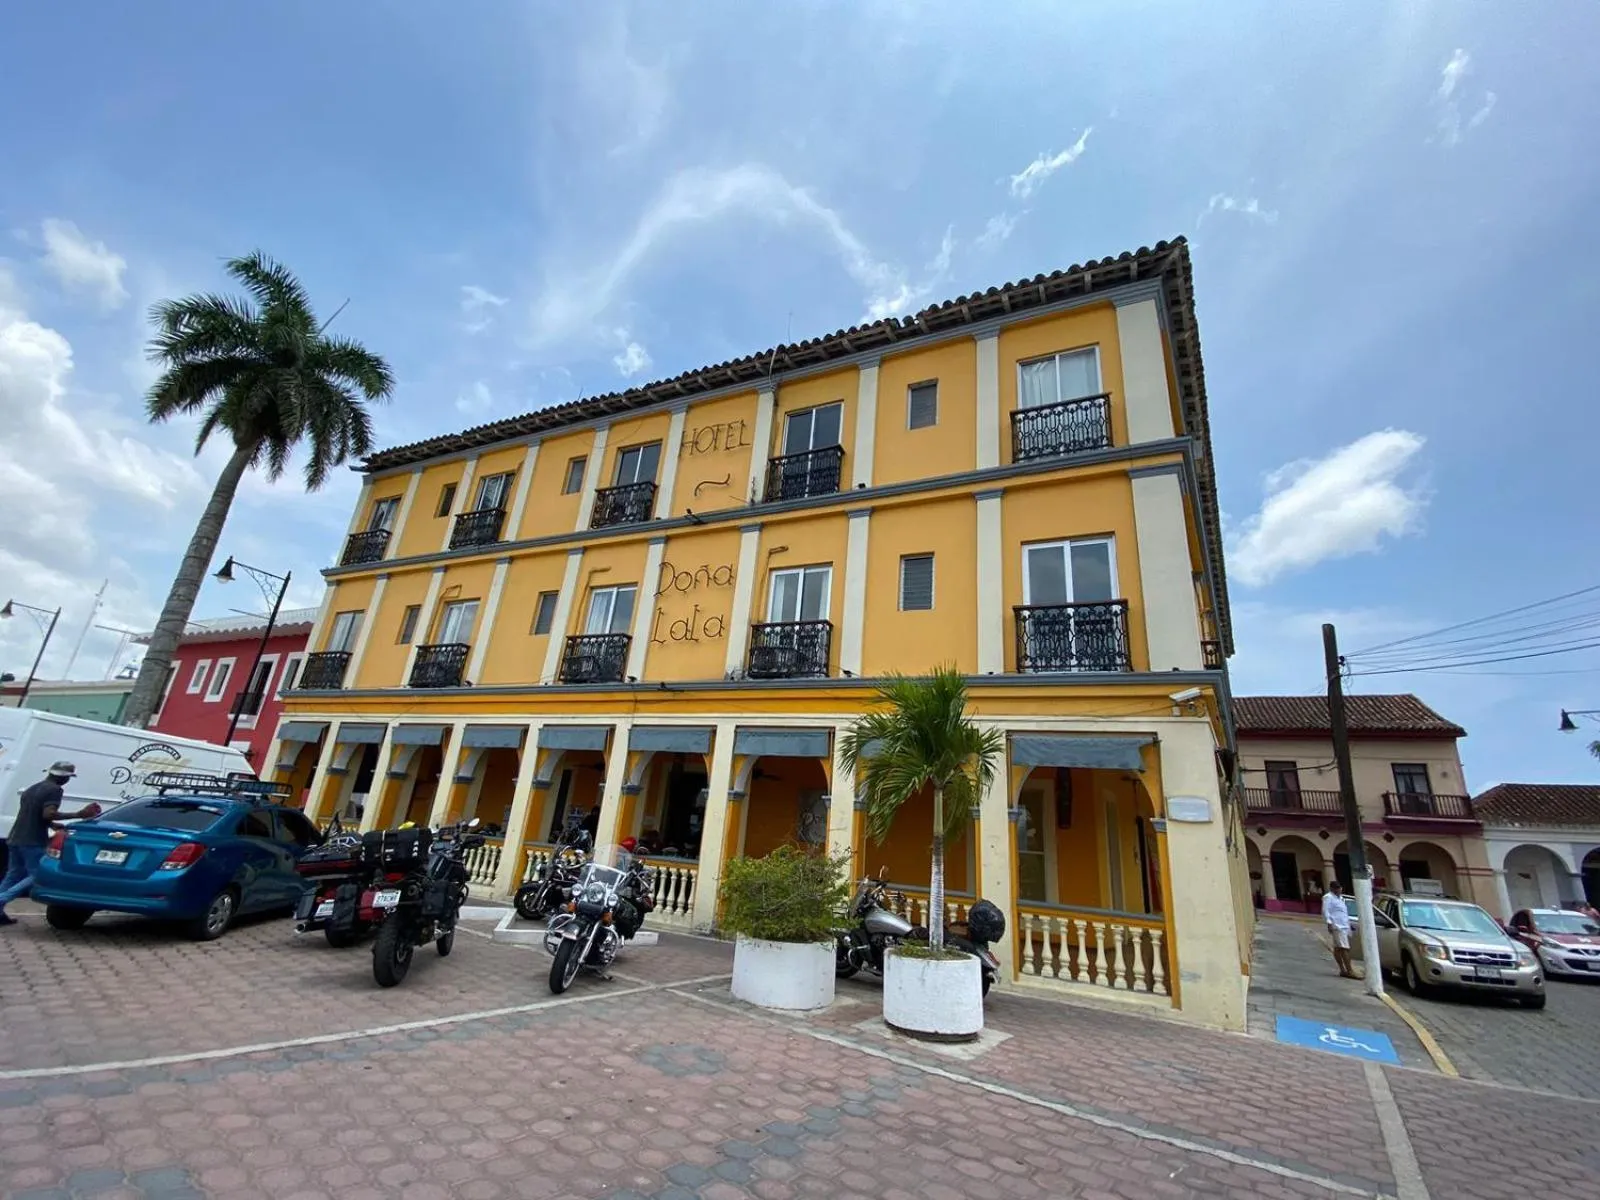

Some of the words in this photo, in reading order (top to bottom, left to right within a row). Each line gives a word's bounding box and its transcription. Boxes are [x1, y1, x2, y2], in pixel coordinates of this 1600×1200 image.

[679, 419, 750, 456] HOTEL
[654, 561, 733, 596] Doña
[651, 604, 725, 644] Lala
